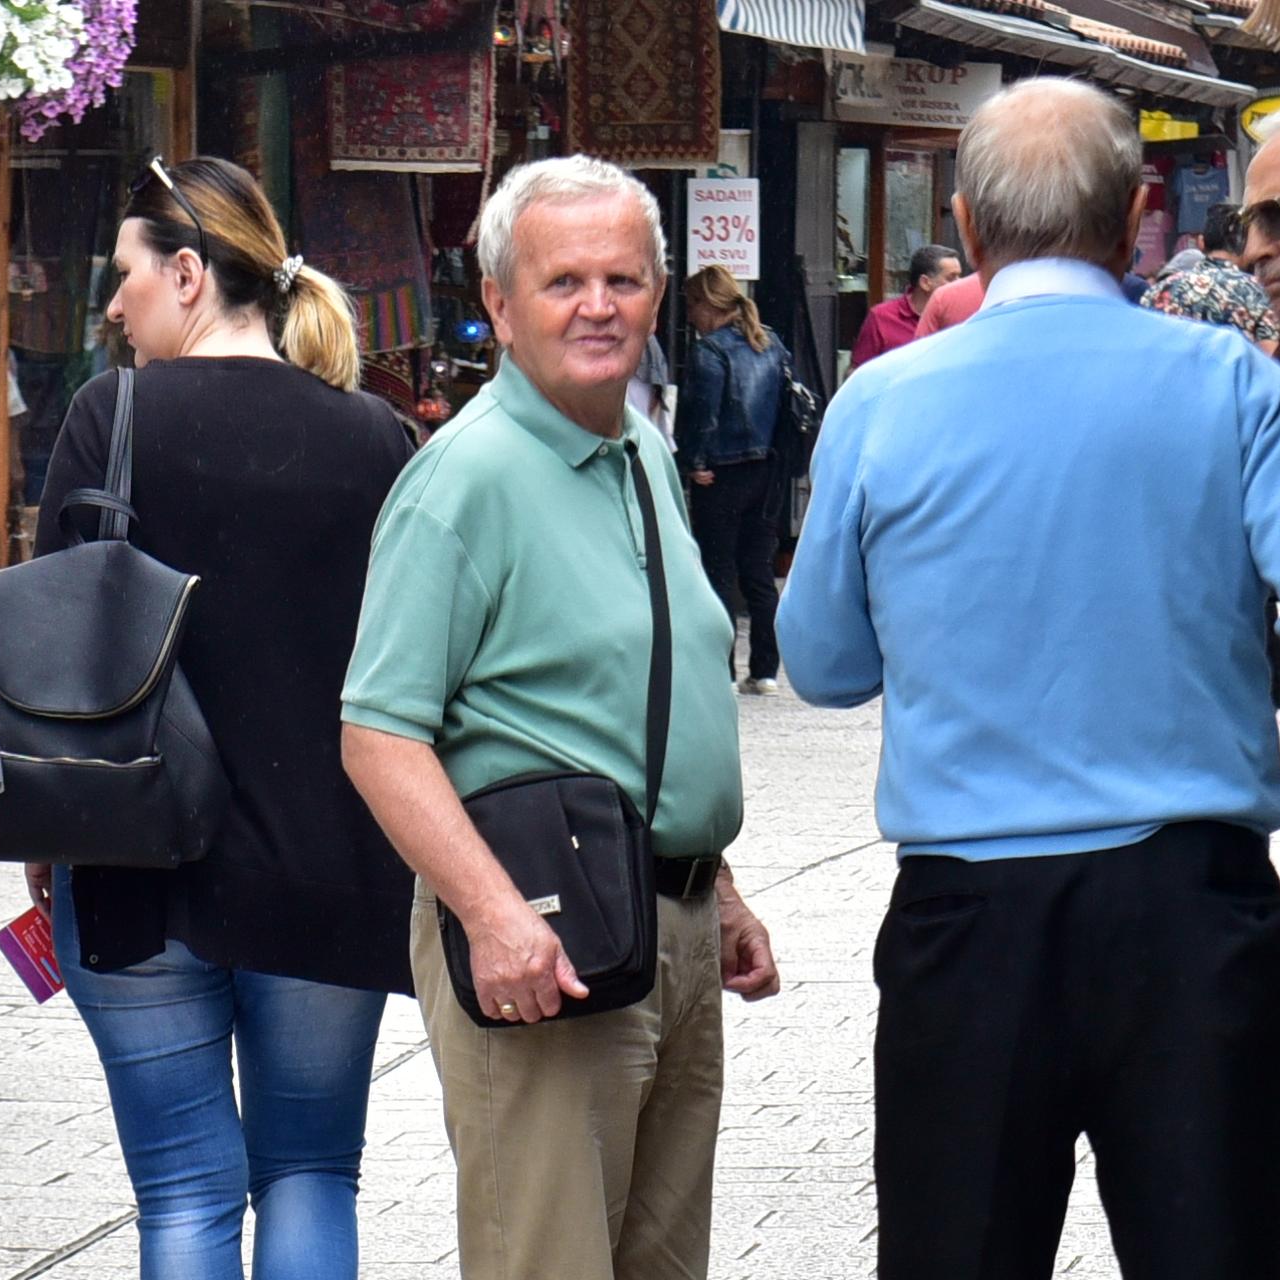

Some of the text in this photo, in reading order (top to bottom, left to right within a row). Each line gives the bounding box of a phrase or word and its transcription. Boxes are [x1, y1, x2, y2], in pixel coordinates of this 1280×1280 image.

[692, 215, 756, 242] -33%
[697, 249, 748, 260] NA SVU
